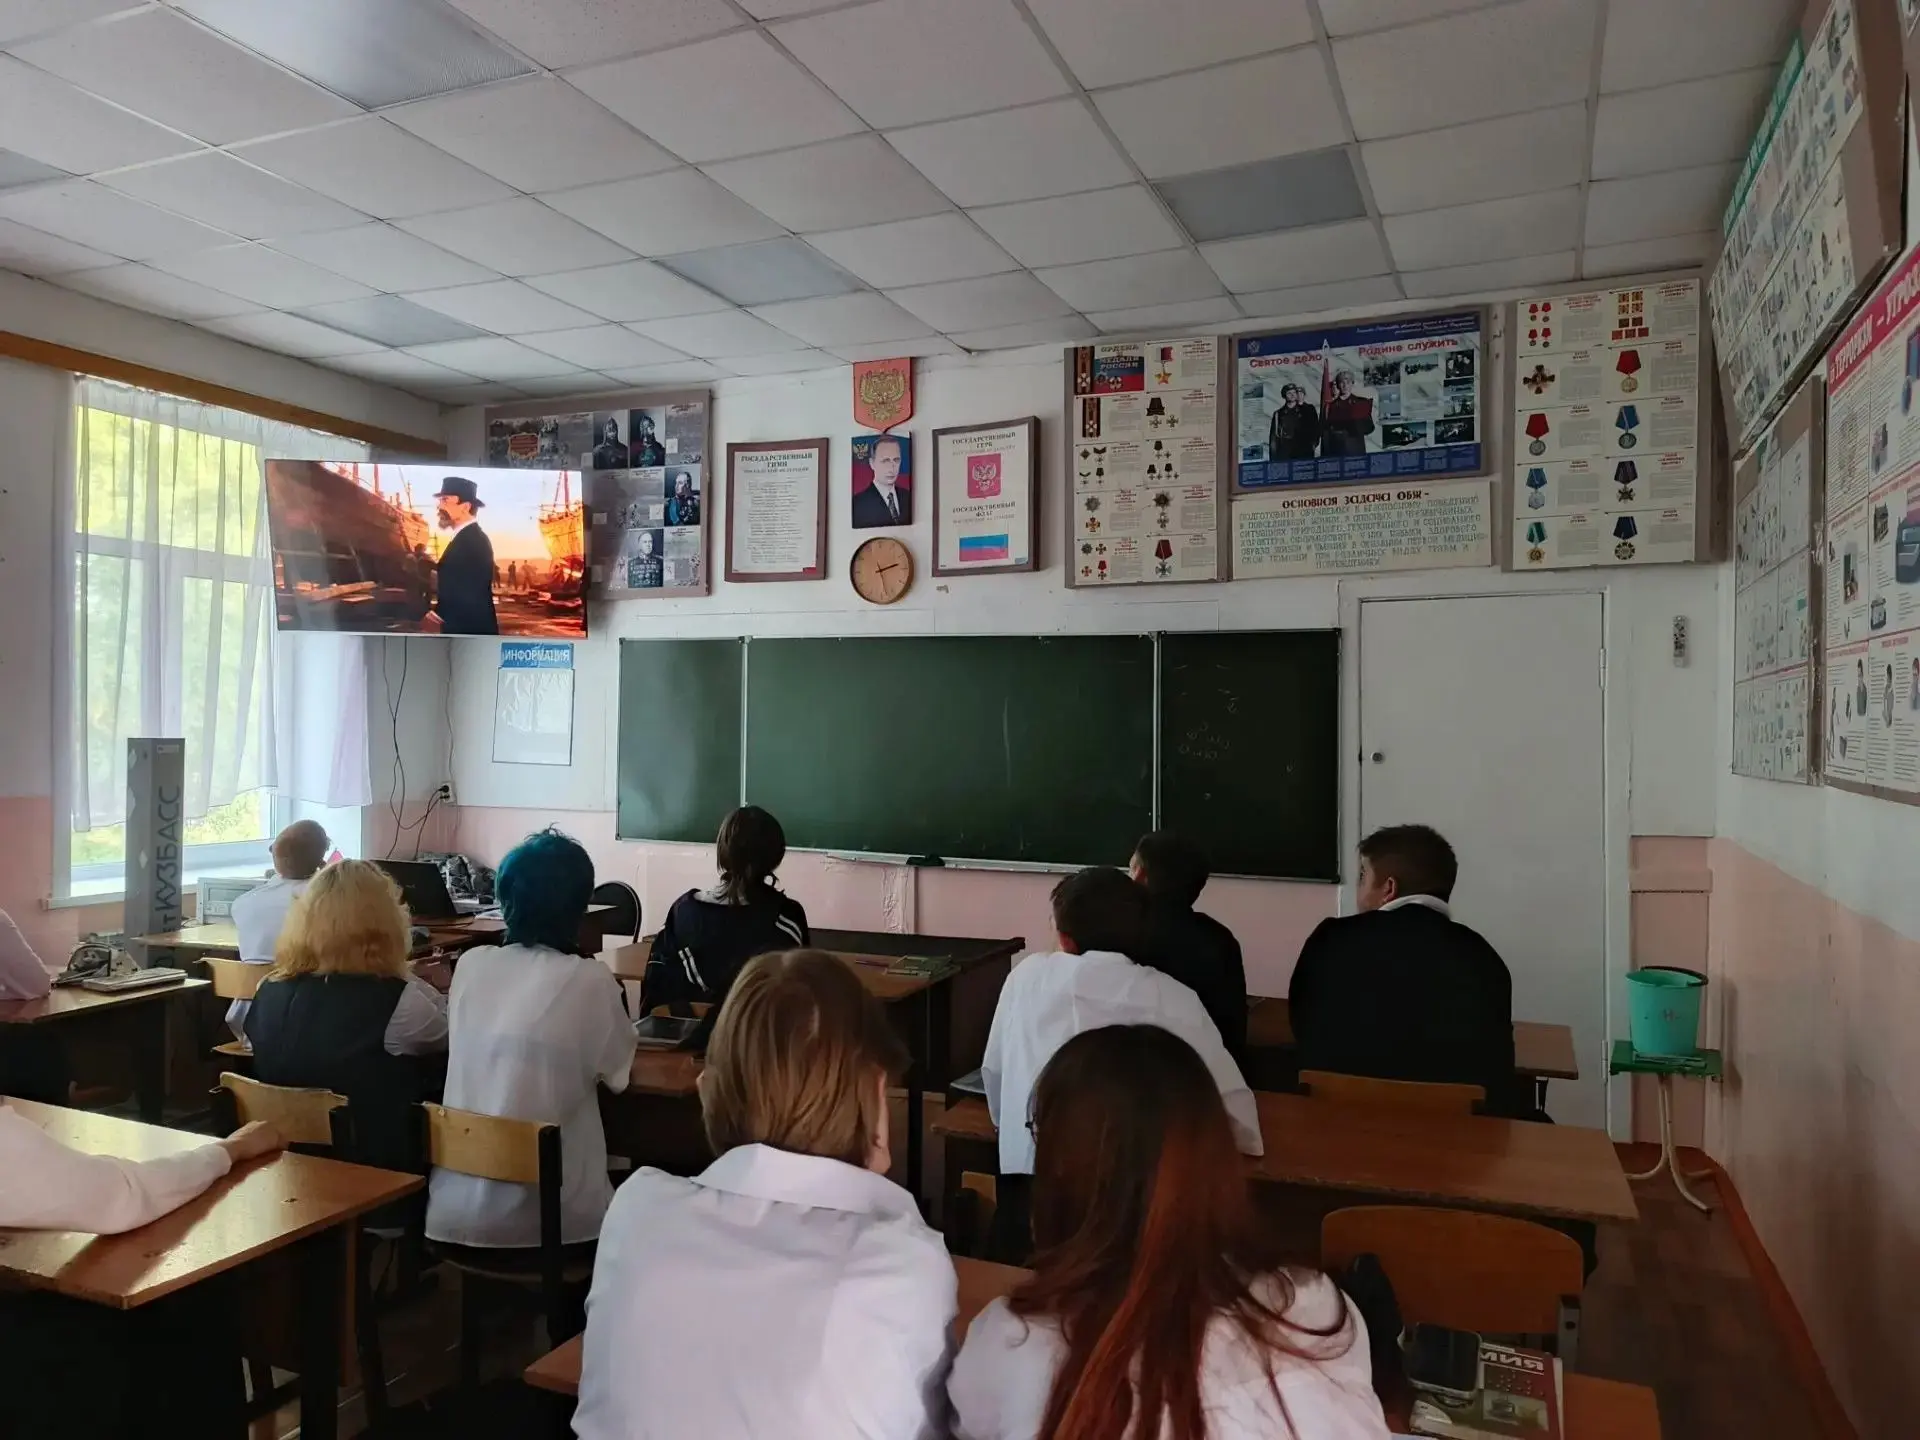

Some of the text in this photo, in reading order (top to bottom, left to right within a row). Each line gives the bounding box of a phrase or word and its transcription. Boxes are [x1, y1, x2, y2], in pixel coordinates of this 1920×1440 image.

[1101, 345, 1139, 353] ОРДЕНА
[1358, 338, 1458, 356] Родине служить
[1834, 314, 1873, 380] ТЕРРОРИЗМ
[1249, 354, 1322, 369] Святое дело
[951, 432, 1016, 445] ГОСУДАРСТВЕННЫЙ
[741, 452, 813, 463] ГОСУДАРСТВЕННЫЙ
[1397, 490, 1422, 501] ОБЖ
[951, 501, 1016, 514] ГОСУДАРСТВЕННЫЙ
[504, 648, 570, 662] ИНФОРМАЦИЯ
[155, 786, 180, 911] КУЗБАСС
[1480, 1351, 1544, 1371] МИЯ
